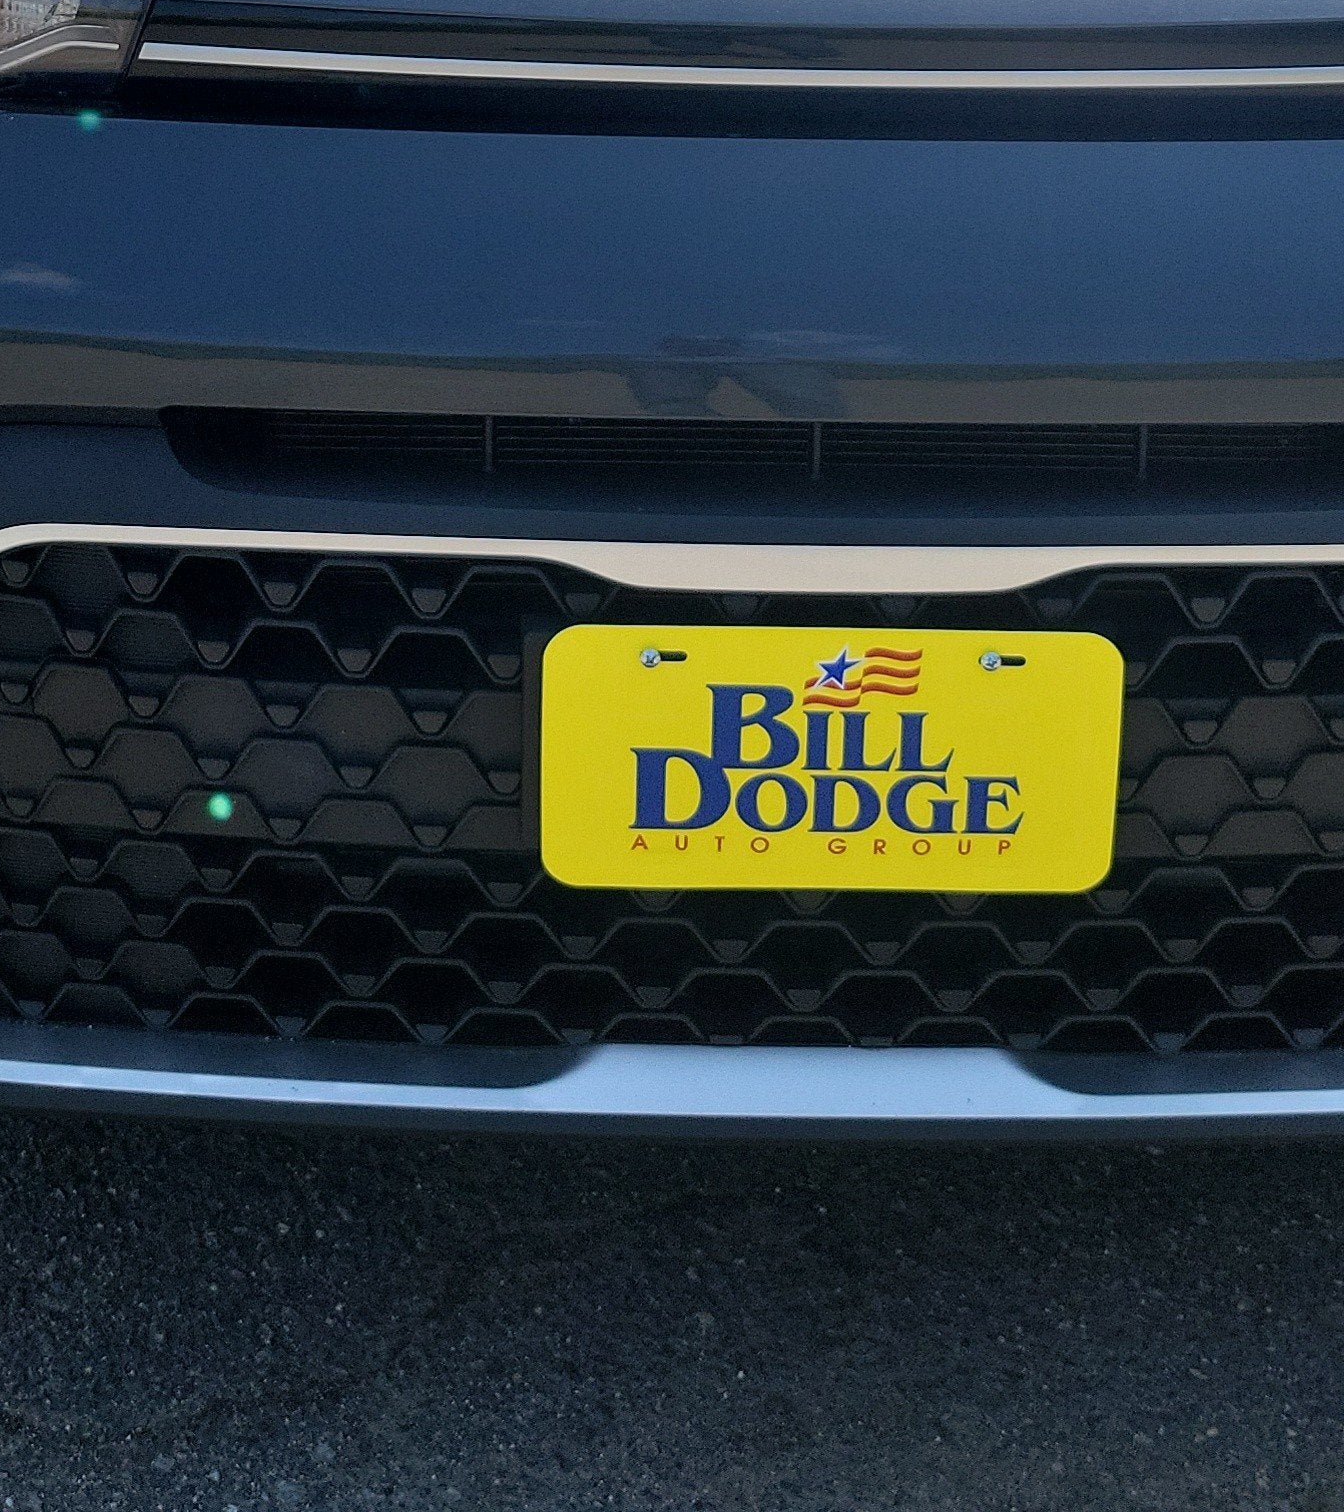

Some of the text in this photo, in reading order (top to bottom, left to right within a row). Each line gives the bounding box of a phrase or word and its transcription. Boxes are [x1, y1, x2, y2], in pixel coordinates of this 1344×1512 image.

[705, 683, 955, 773] BILL
[628, 747, 1025, 835] DODGE
[630, 834, 1012, 857] AUTO GROUP
